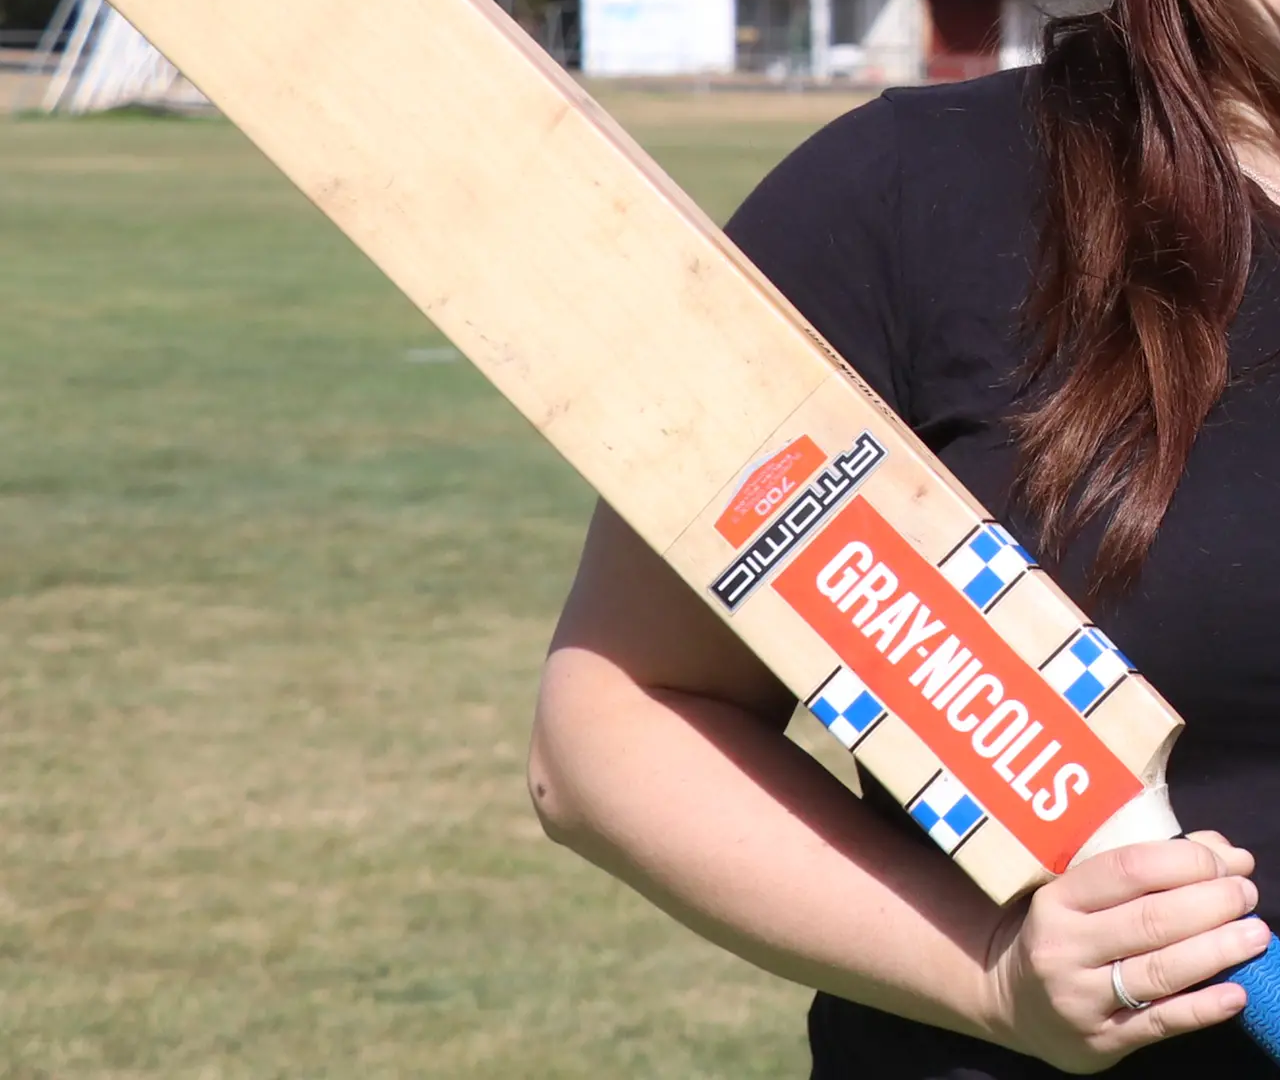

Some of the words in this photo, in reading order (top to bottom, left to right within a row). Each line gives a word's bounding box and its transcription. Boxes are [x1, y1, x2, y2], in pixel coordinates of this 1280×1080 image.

[717, 438, 880, 602] ATOMIC
[754, 476, 796, 516] 700
[815, 539, 1091, 822] GRAY-NICOLLS
